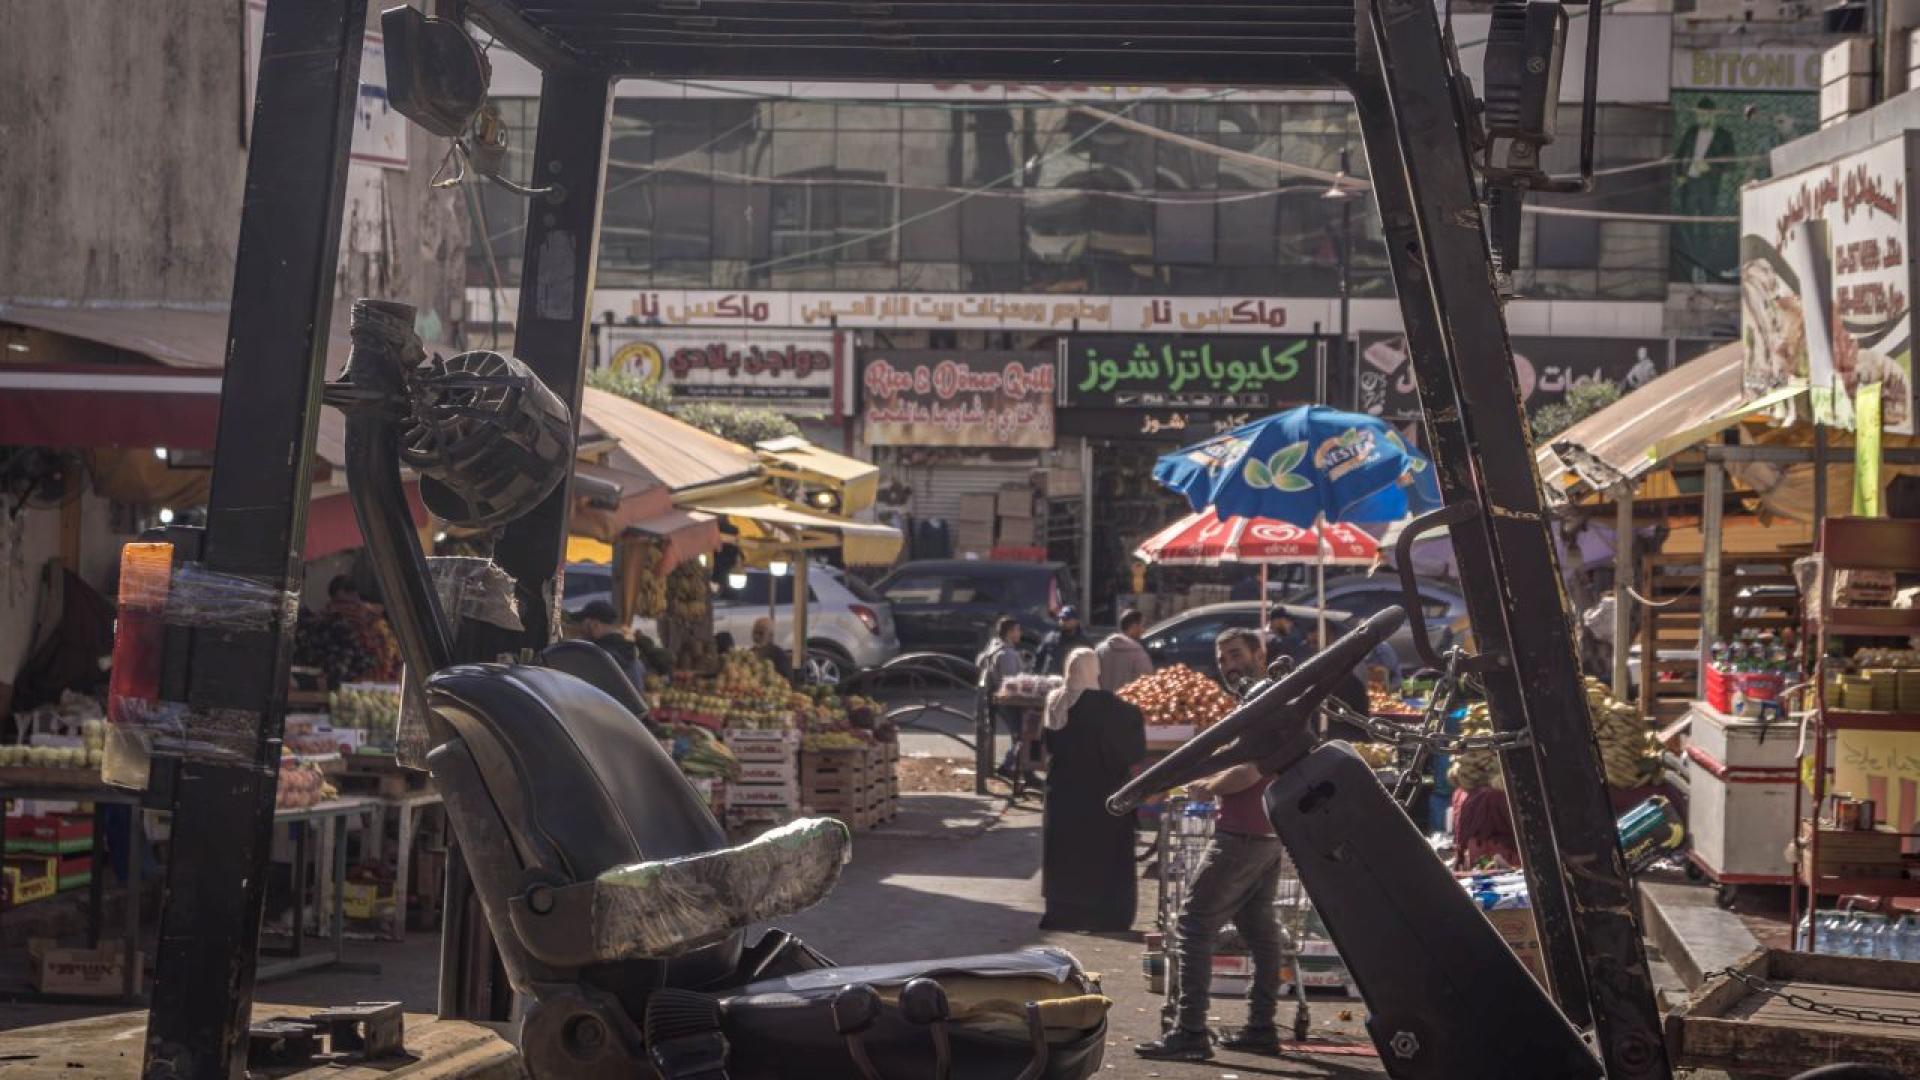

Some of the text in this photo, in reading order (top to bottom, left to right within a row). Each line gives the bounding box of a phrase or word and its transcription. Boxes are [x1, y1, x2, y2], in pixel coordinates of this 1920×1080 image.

[1692, 50, 1795, 86] BITONI
[666, 294, 769, 322] ماكس
[1140, 299, 1286, 329] ماكس نار
[743, 344, 832, 379] دواجن
[865, 360, 1055, 398] Rice & Döner Grill
[1079, 342, 1159, 392] شوز
[1163, 340, 1308, 392] كليوباترا
